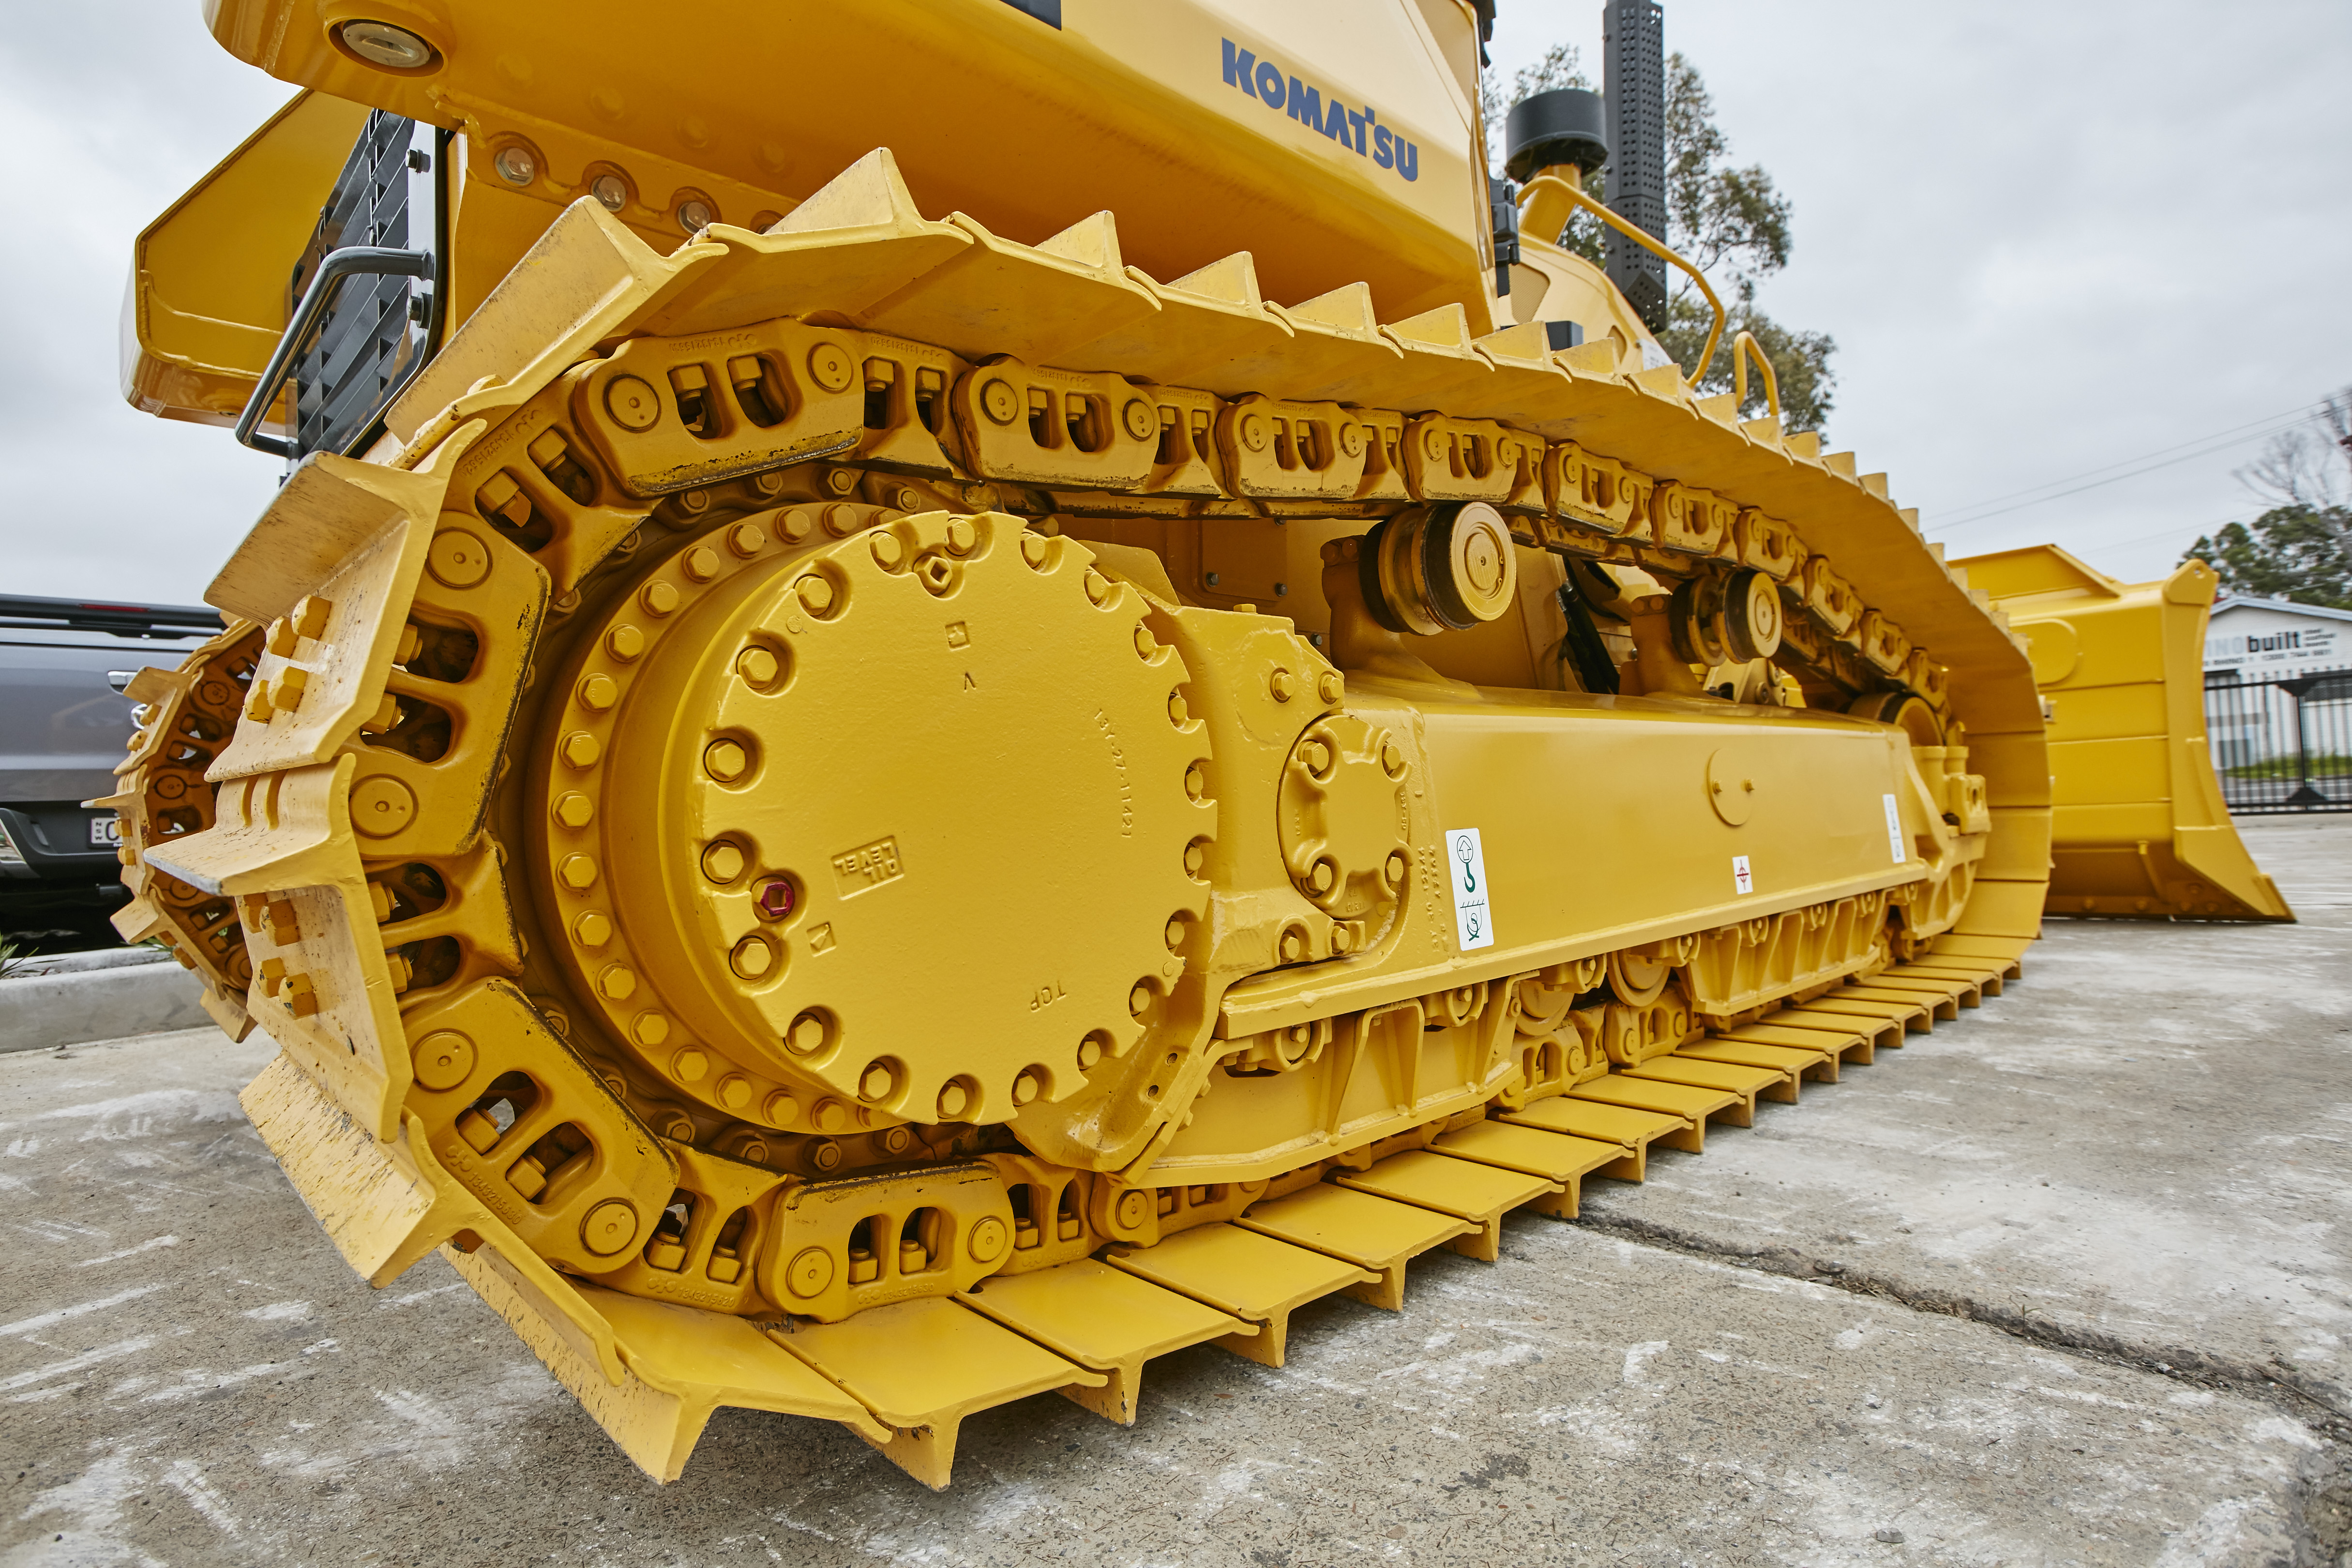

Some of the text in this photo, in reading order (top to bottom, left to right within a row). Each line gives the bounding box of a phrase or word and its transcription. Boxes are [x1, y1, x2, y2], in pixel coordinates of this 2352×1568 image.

[1221, 37, 1418, 182] KOMATSU
[2246, 631, 2300, 653] built
[1094, 708, 1132, 838] 13Y-27-11421
[833, 842, 895, 876] LEVEL
[864, 859, 899, 883] OIL
[1030, 980, 1067, 1012] TOP
